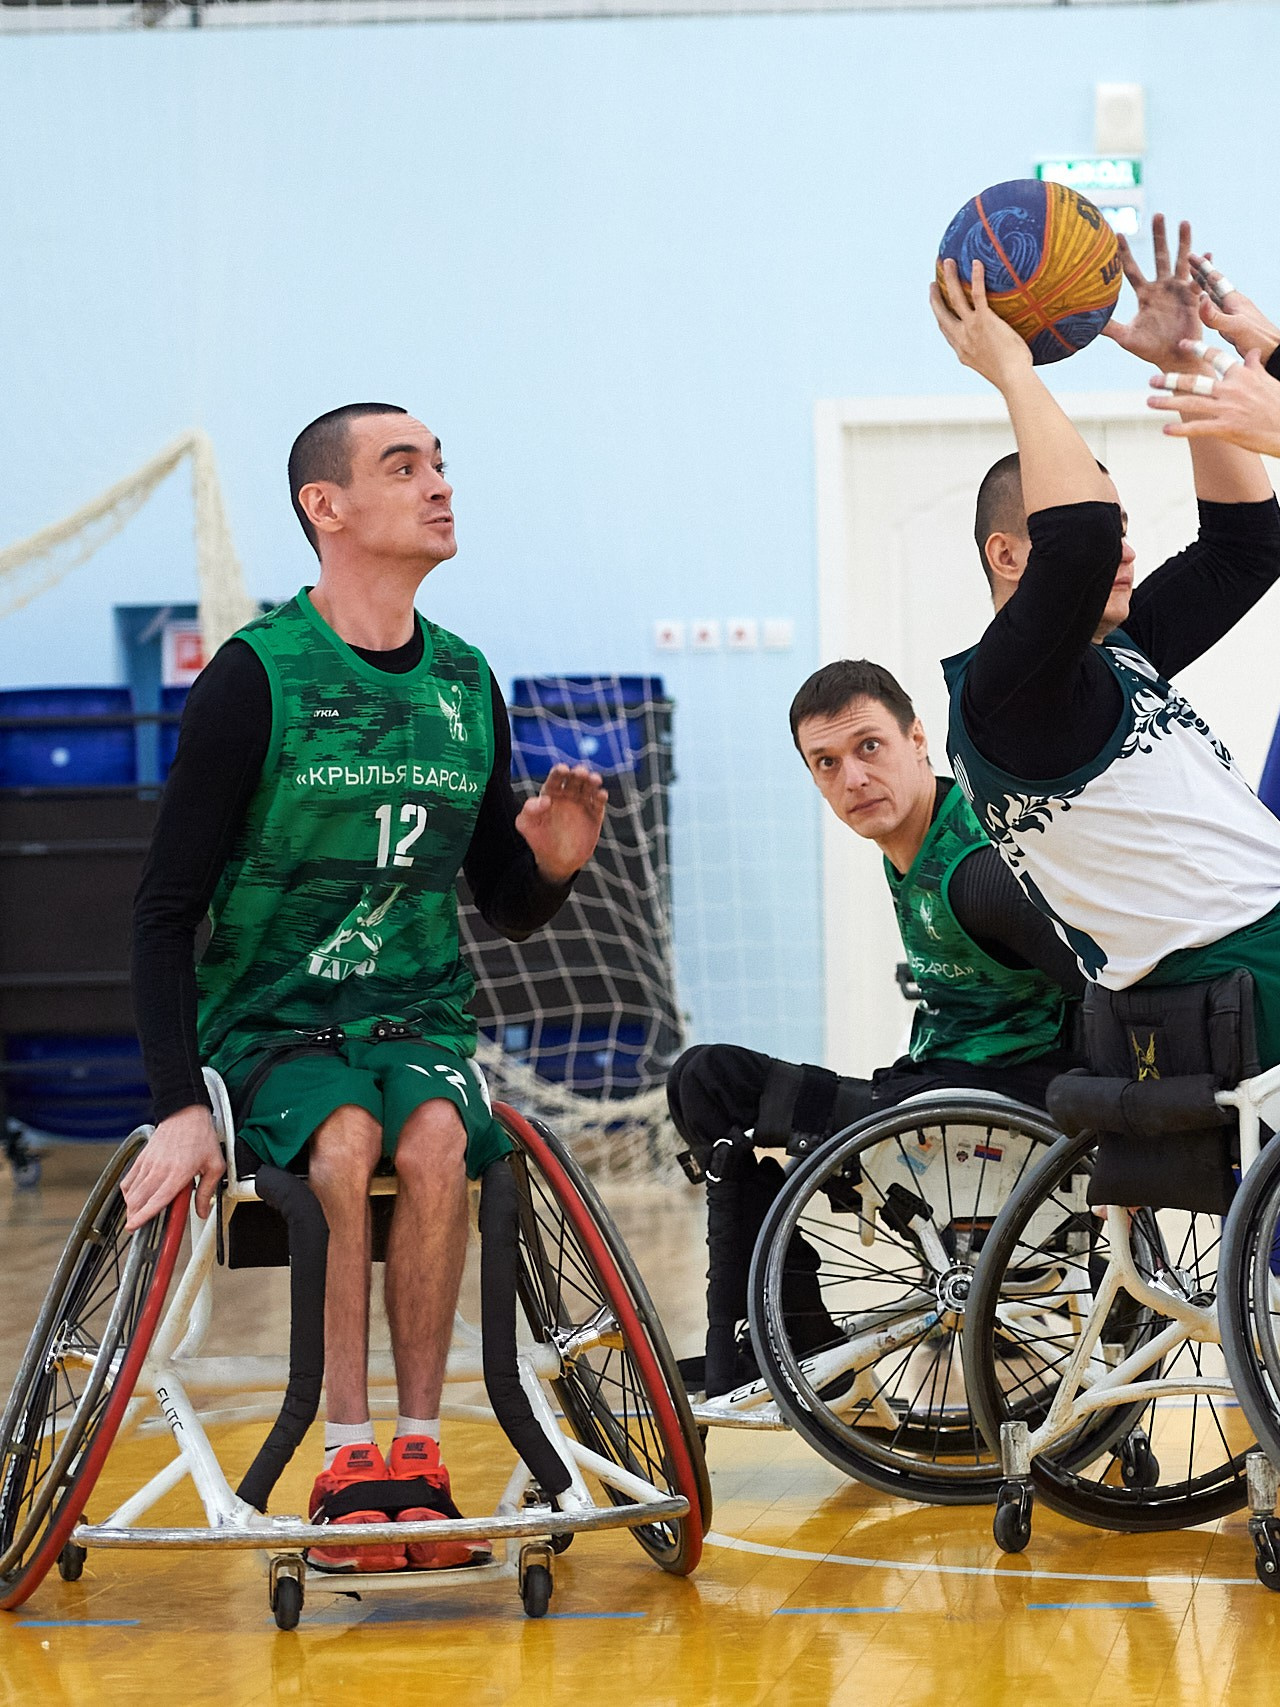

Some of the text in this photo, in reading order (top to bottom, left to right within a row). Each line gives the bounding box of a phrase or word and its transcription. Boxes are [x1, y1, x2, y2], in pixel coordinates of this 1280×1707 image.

[296, 765, 478, 793] «КРЫЛЬЯ БАРСА»
[374, 803, 428, 868] 12
